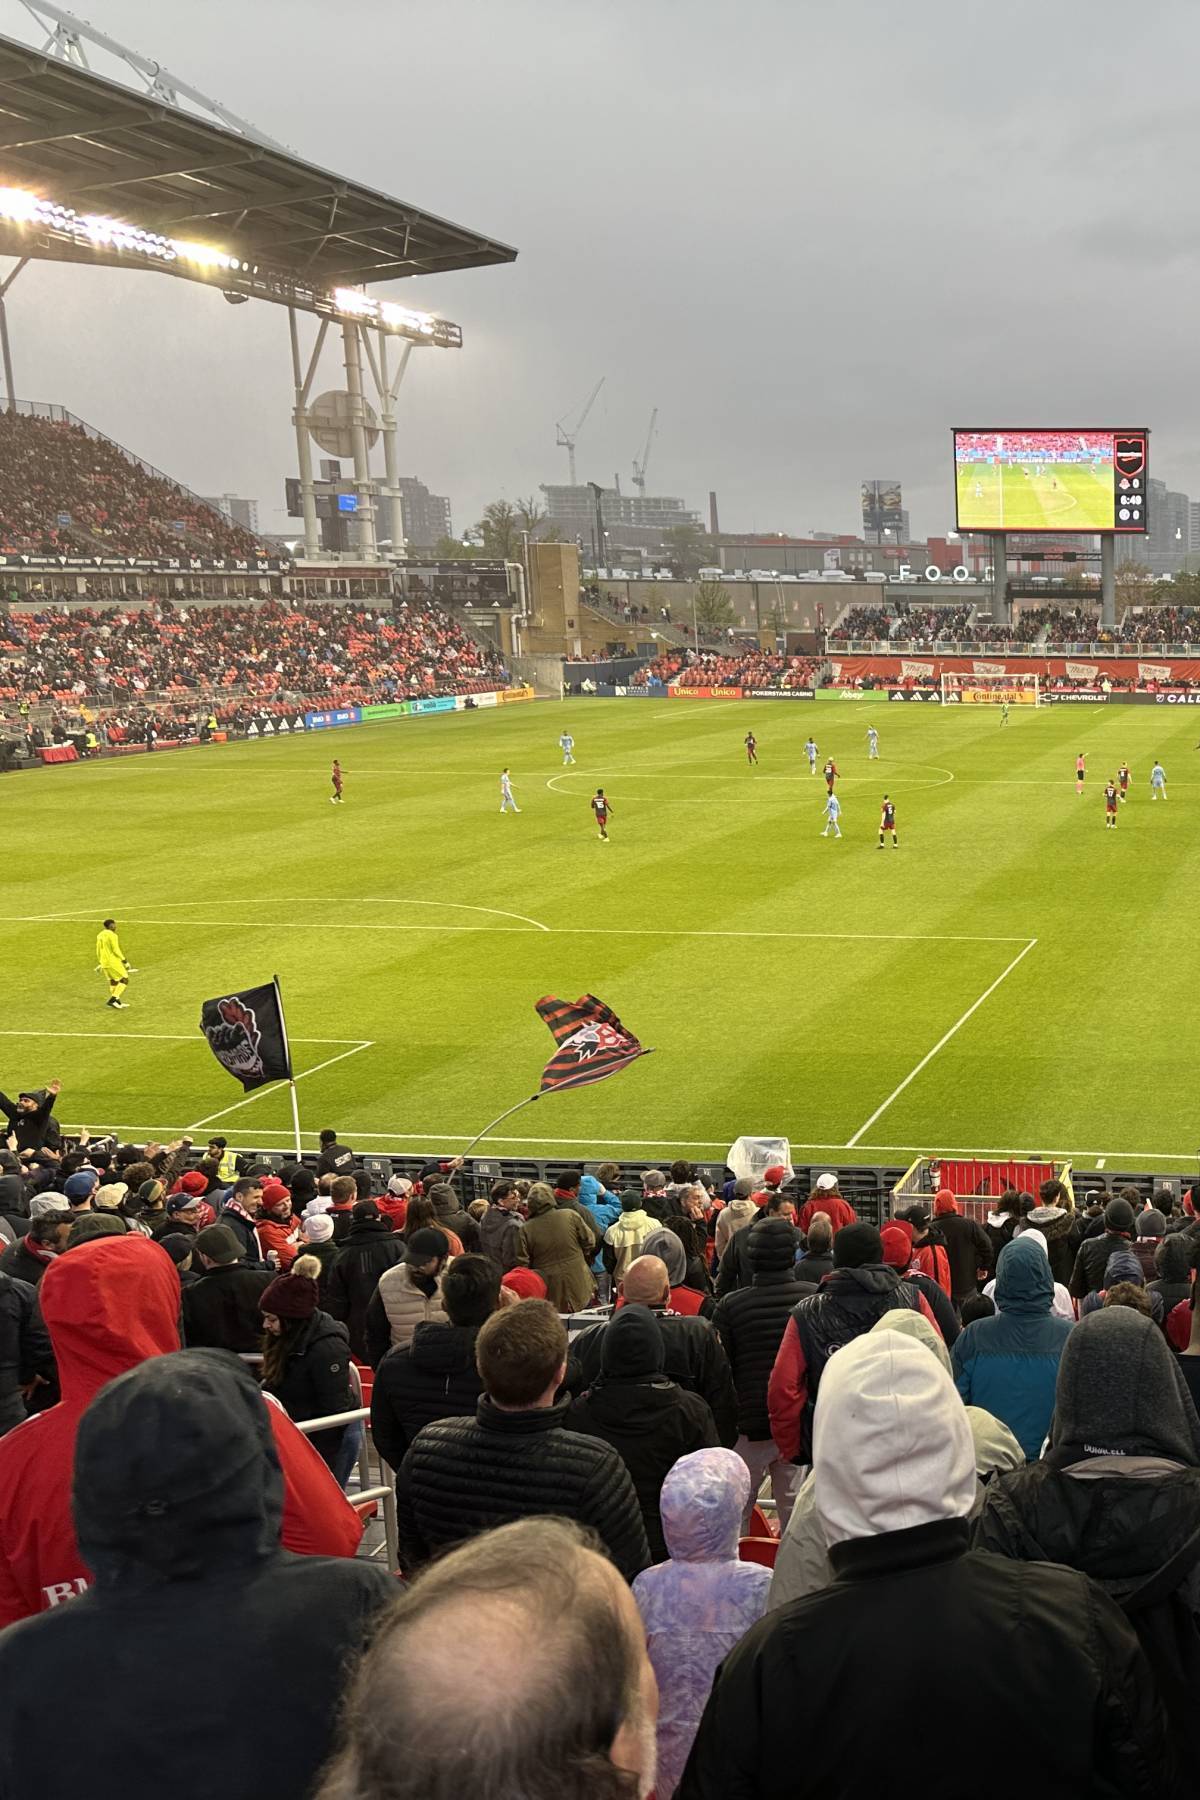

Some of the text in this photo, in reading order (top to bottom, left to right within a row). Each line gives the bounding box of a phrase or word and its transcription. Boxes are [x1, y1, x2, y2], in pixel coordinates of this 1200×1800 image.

[1132, 478, 1140, 488] 0
[1132, 510, 1140, 520] 0
[674, 687, 698, 696] Unico
[711, 687, 736, 696] Unico
